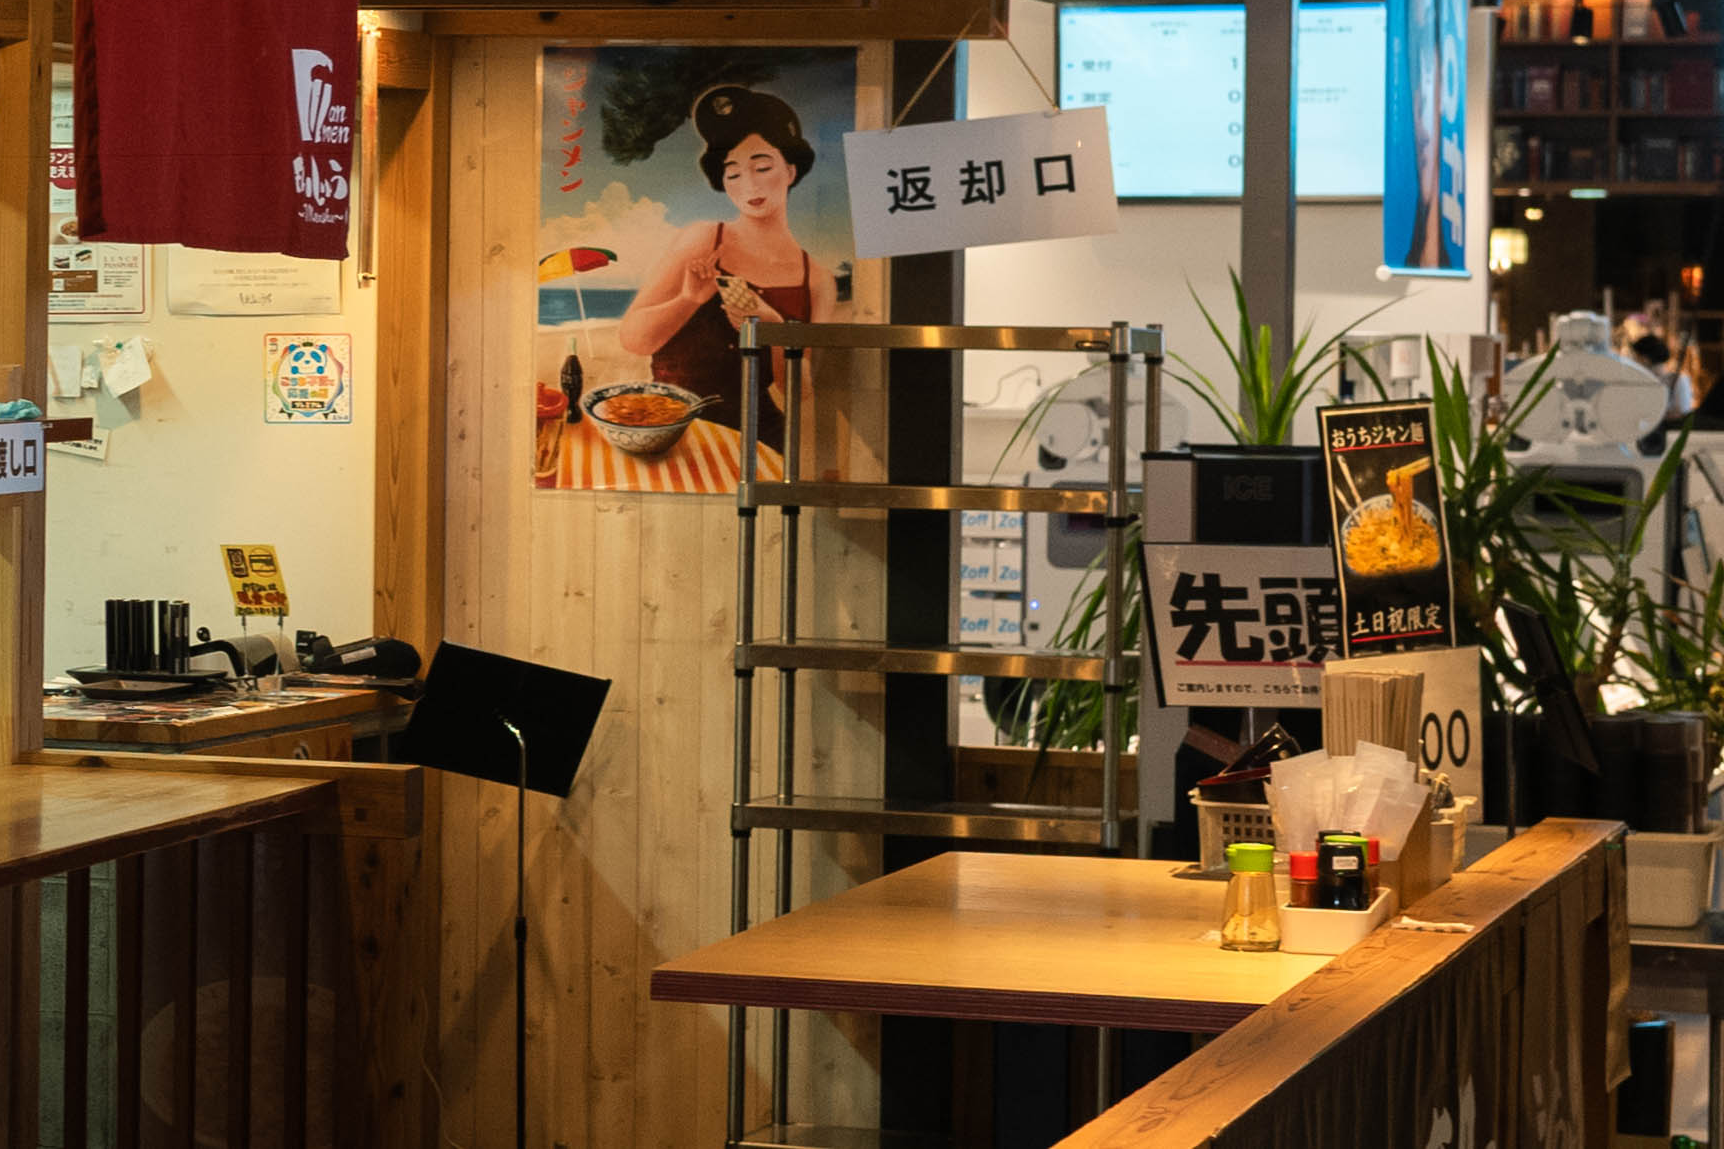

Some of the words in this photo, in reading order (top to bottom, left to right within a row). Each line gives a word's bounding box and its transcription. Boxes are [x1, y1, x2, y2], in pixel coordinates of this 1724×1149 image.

[886, 153, 1078, 216] 返却口
[1222, 475, 1276, 502] ICE
[1351, 601, 1443, 637] 土日祝限定
